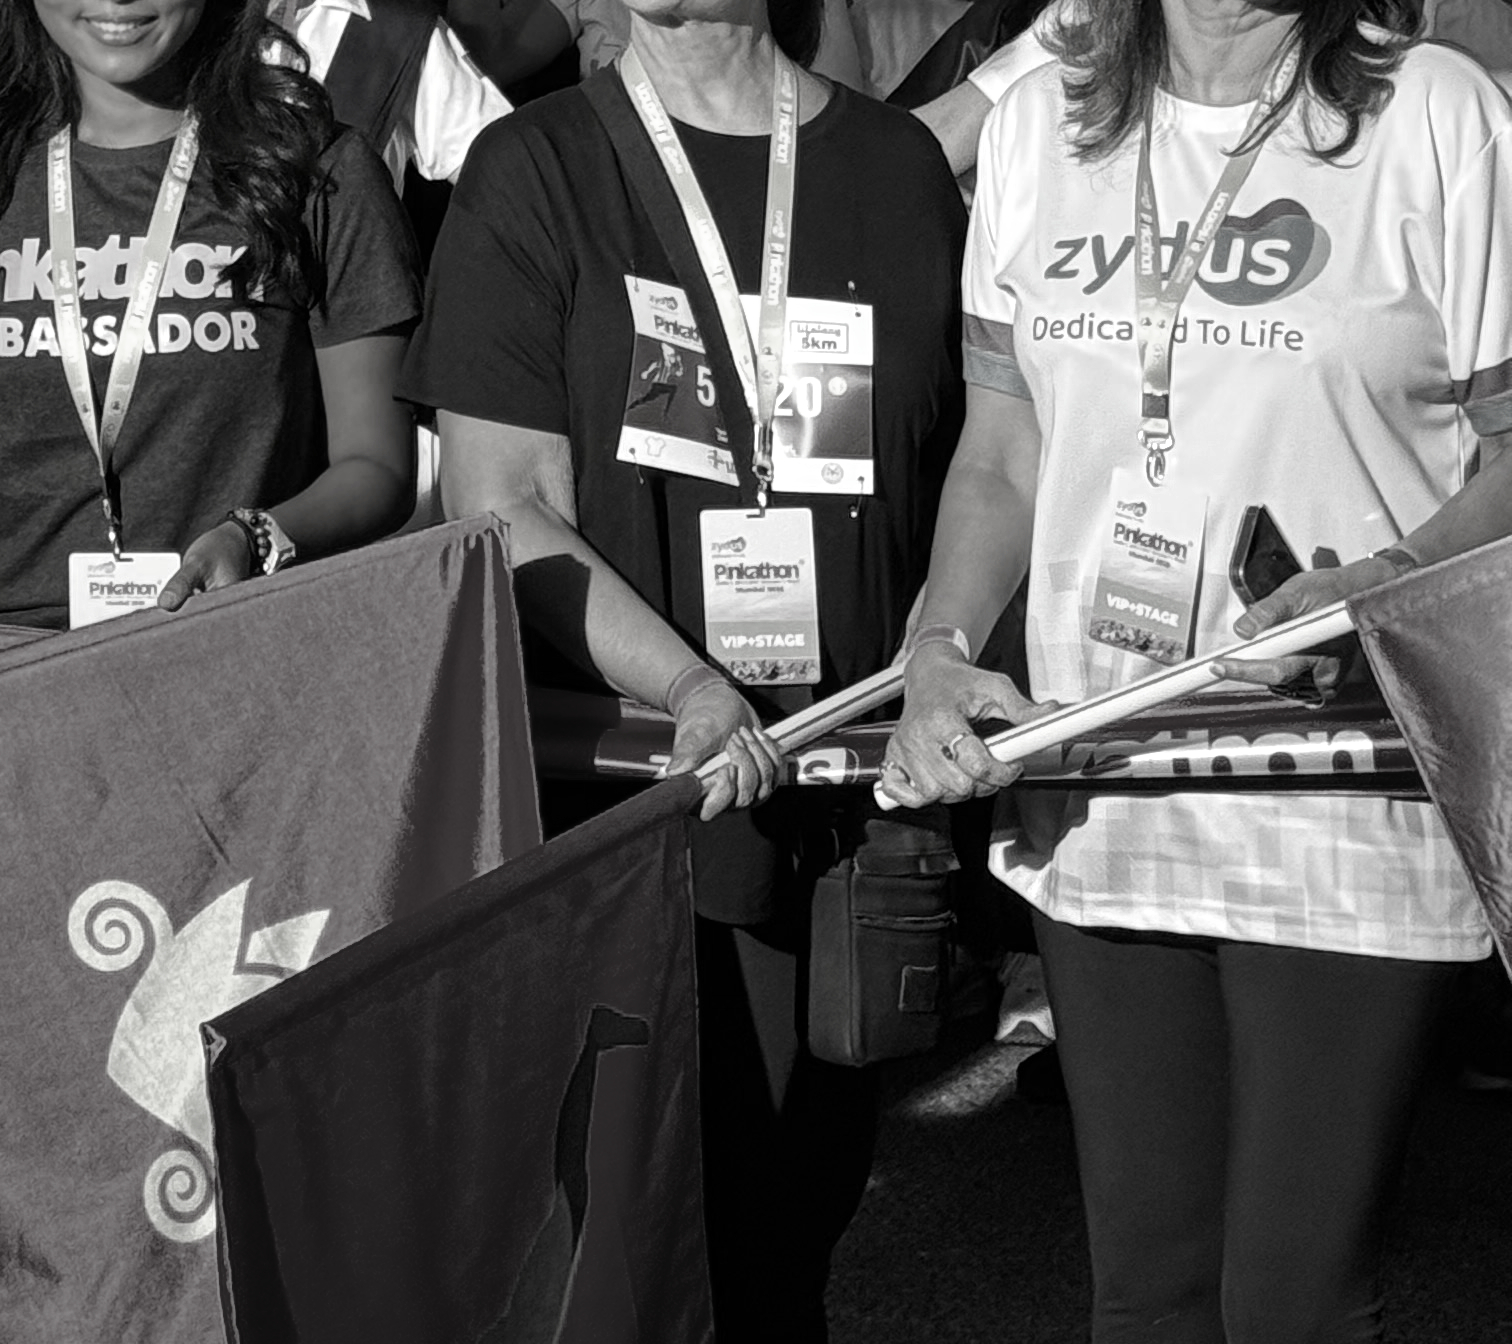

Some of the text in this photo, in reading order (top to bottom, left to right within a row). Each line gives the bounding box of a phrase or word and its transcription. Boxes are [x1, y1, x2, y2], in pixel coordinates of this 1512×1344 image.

[801, 337, 838, 350] 5km
[1196, 319, 1231, 347] To
[1240, 319, 1304, 353] Life
[1106, 592, 1180, 628] VIP+STAGE
[719, 633, 805, 649] VIP+STAGE
